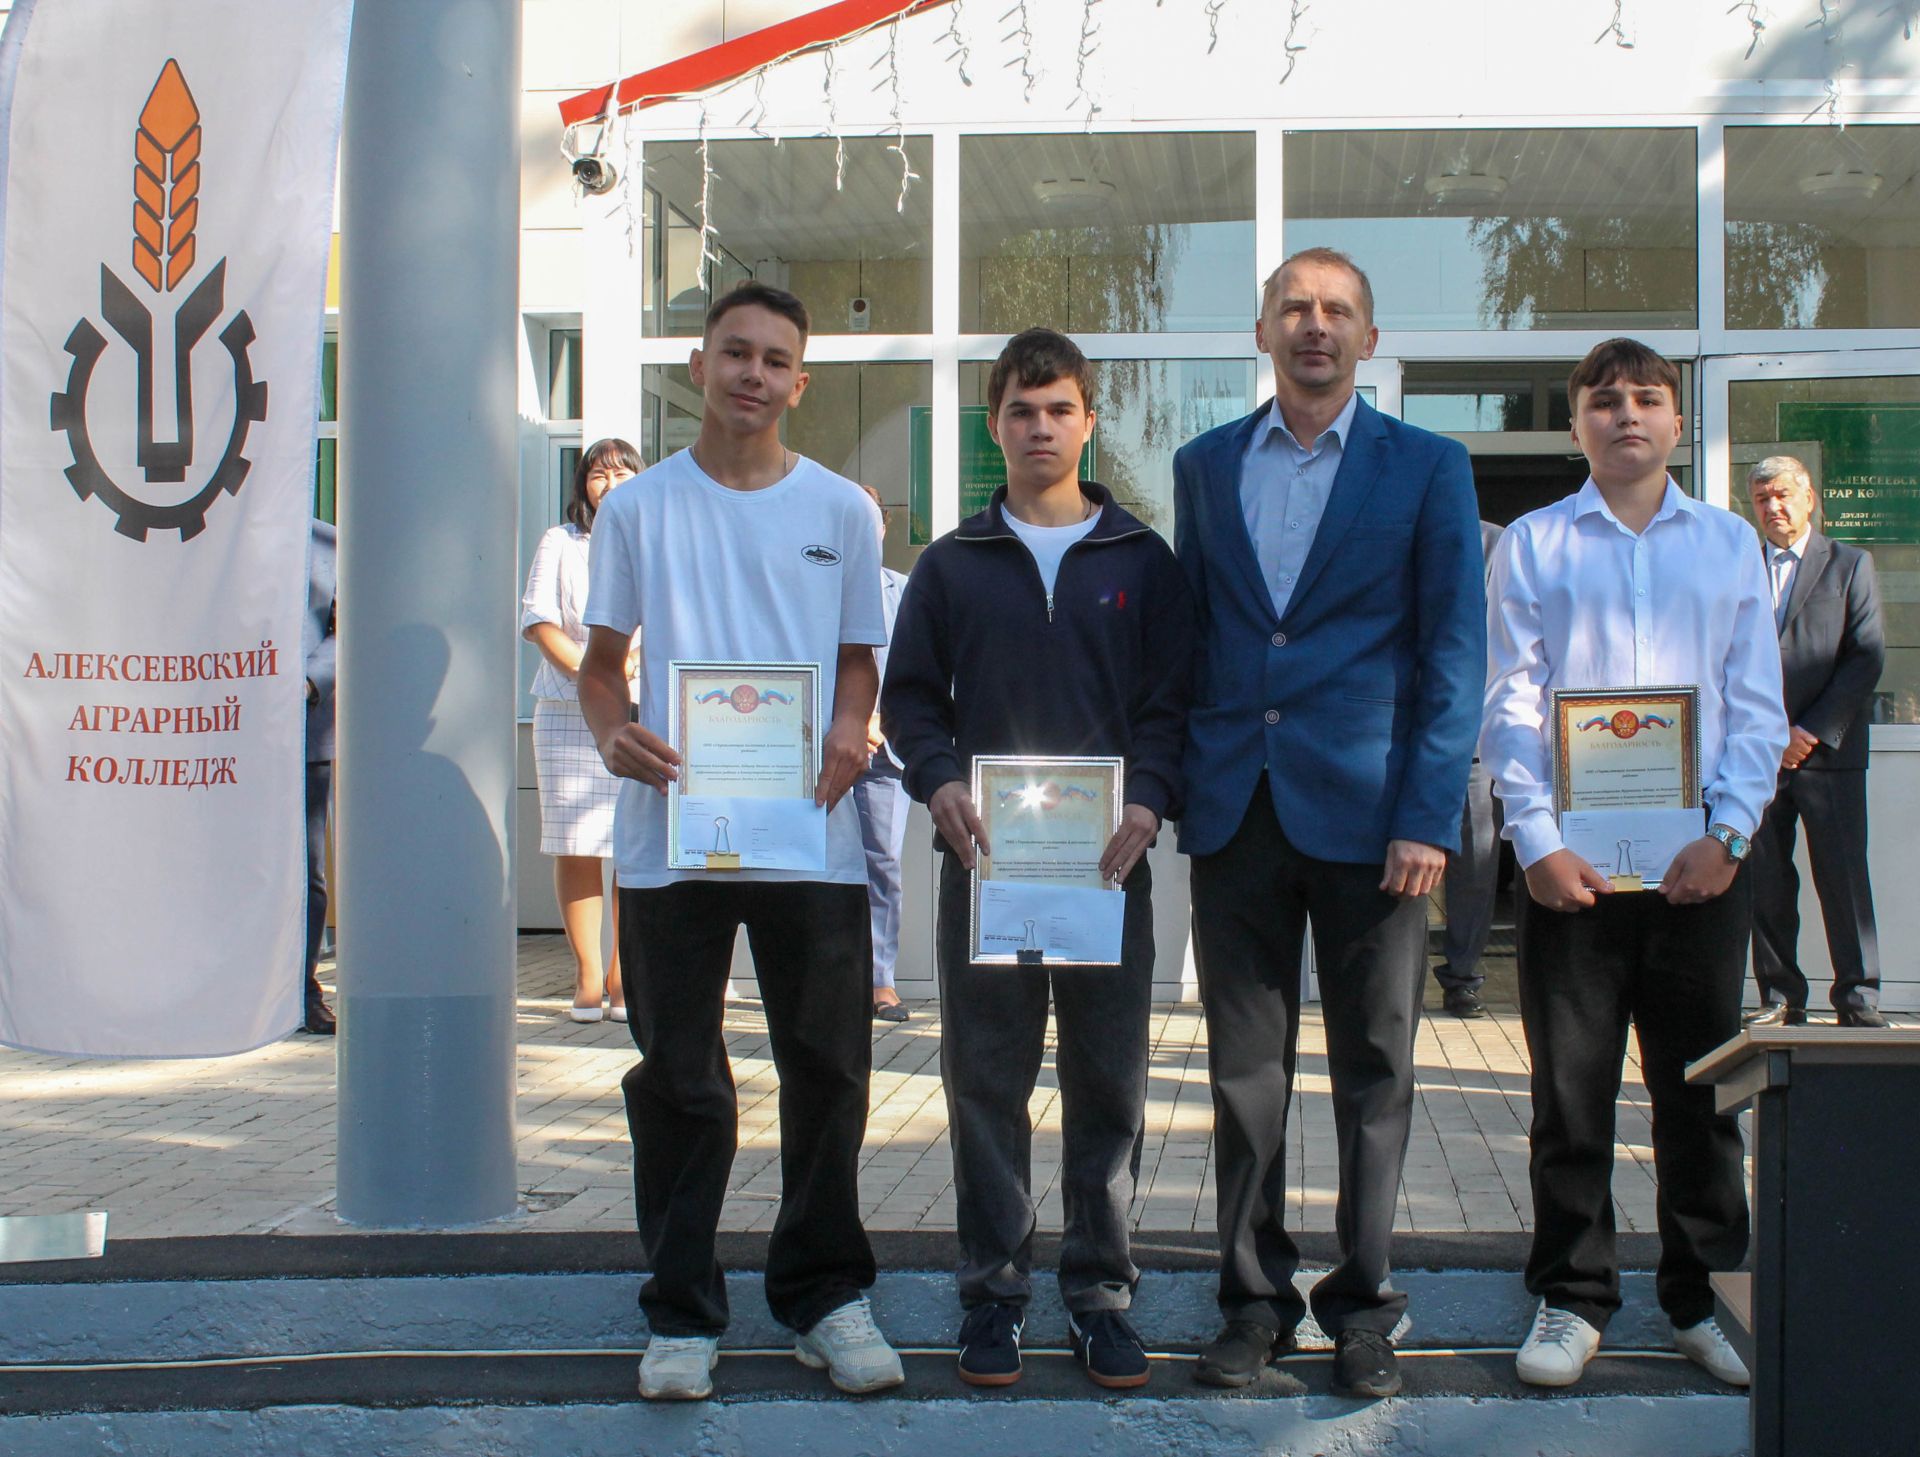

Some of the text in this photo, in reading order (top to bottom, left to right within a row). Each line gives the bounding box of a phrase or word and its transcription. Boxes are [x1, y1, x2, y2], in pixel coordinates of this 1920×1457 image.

[1823, 488, 1853, 498] ГРАР
[24, 640, 279, 682] АЛЕКСЕЕВСКИЙ
[68, 696, 242, 734] АГРАРНЫЙ
[65, 755, 238, 792] КОЛЛЕДЖ
